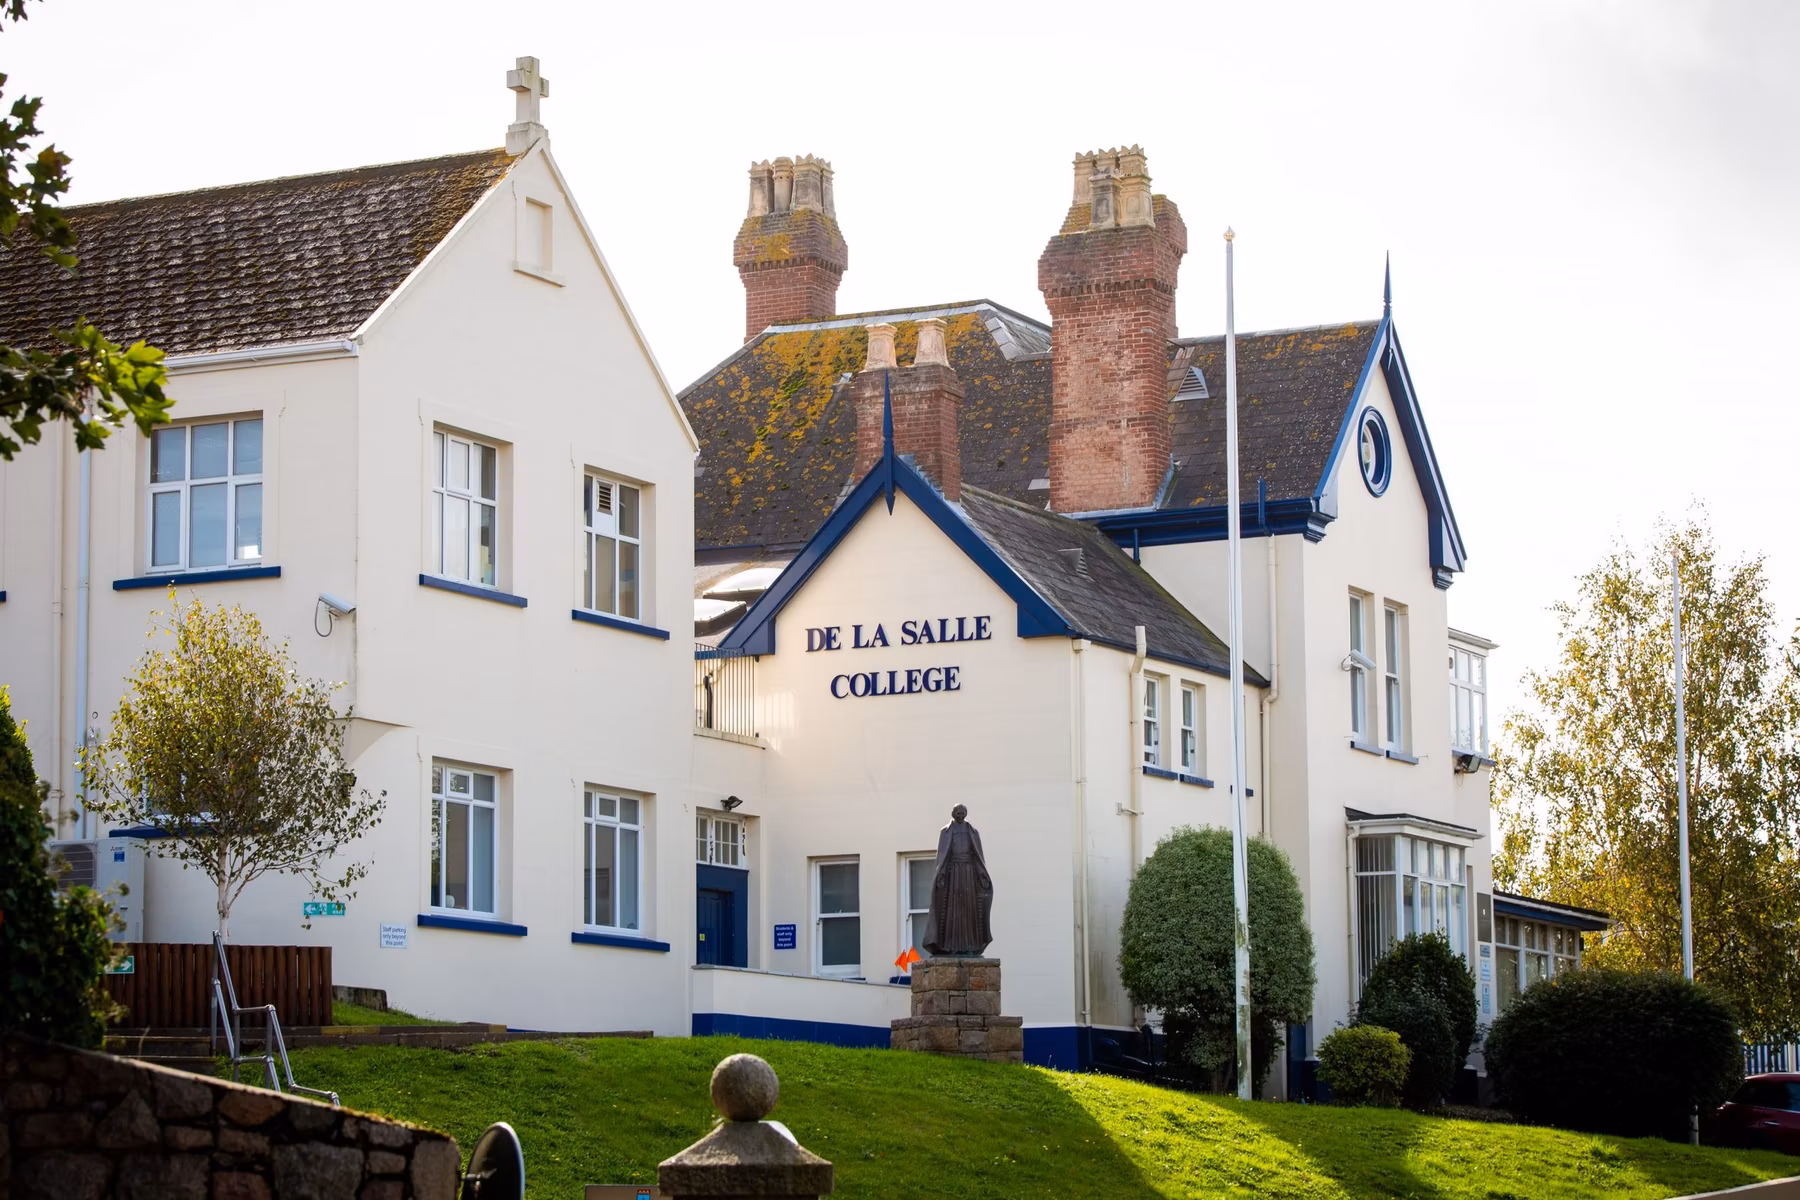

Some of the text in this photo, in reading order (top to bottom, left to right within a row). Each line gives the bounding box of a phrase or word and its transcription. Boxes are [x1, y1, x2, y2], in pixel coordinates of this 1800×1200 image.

[805, 615, 992, 652] DE LA SALLE
[830, 666, 961, 699] COLLEGE
